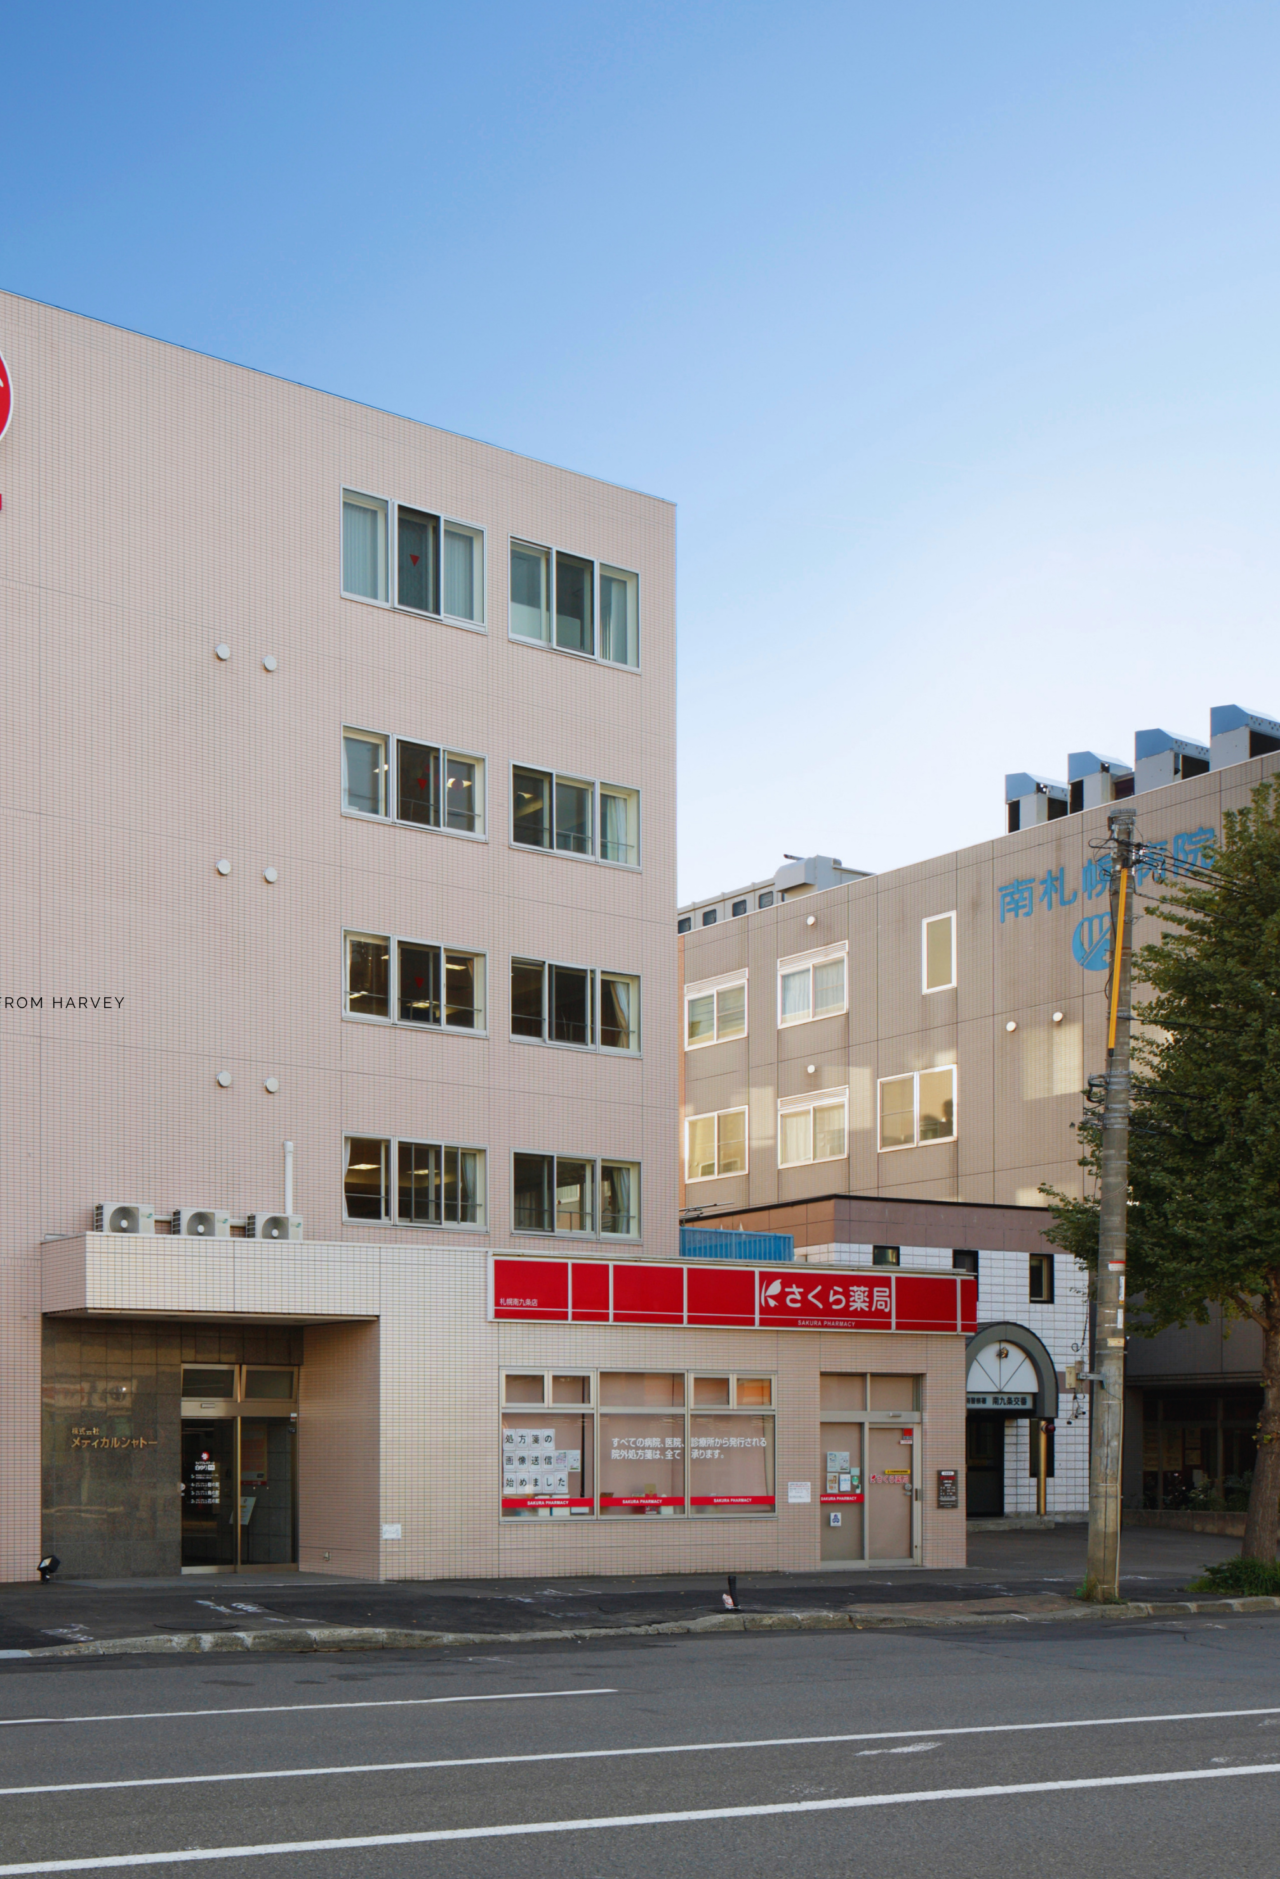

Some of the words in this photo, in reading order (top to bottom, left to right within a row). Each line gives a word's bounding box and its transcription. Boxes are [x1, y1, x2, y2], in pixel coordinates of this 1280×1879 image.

[784, 1284, 891, 1312] さくら薬局
[823, 1320, 856, 1328] PHARMACY
[505, 1434, 553, 1444] 処方箋の
[505, 1455, 553, 1467] 画像送信
[506, 1477, 566, 1488] 始めました
